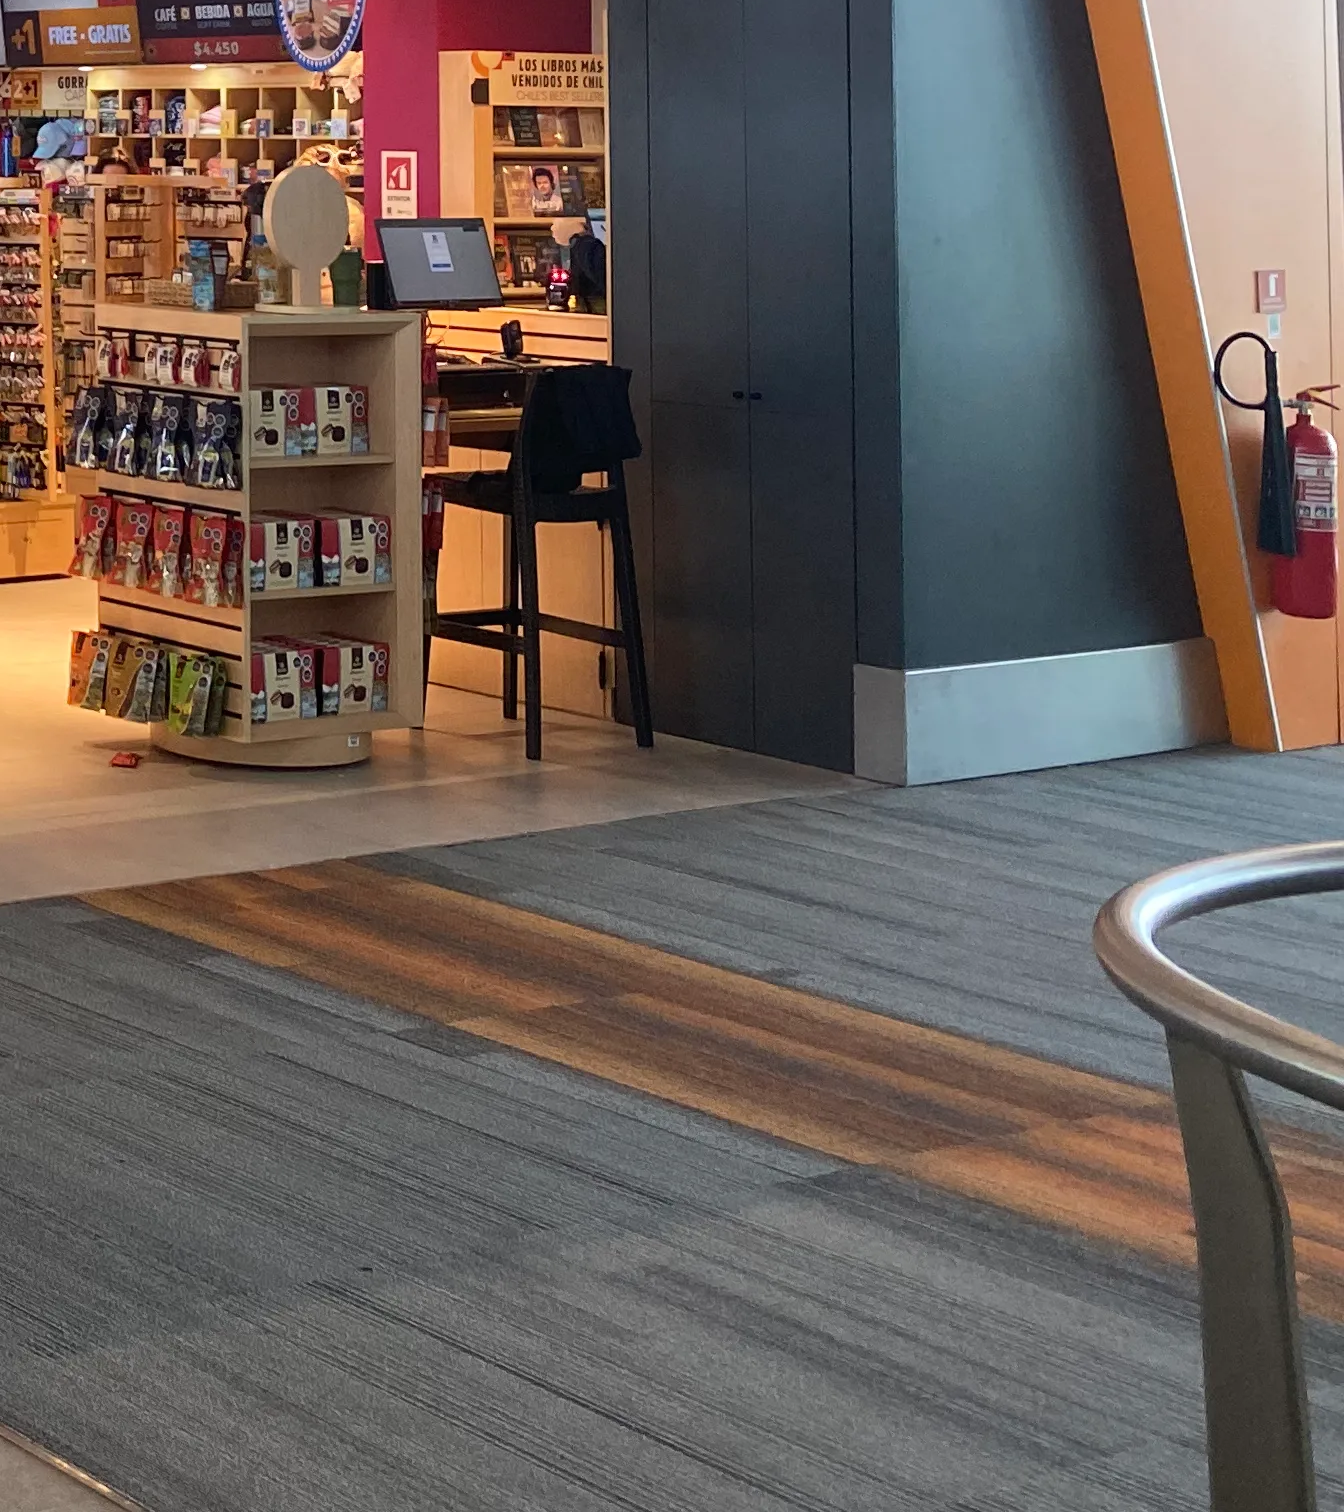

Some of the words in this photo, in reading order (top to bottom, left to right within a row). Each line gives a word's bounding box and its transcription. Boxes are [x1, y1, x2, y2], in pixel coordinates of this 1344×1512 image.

[154, 5, 177, 22] CAFÉ
[194, 5, 231, 19] BEBIDA
[48, 26, 77, 45] FREE
[88, 24, 131, 44] GRATIS
[194, 41, 239, 56] $4.450
[518, 58, 537, 72] LOS
[541, 59, 577, 73] LIBROS
[580, 58, 604, 73] MÁS
[511, 73, 563, 88] VENDIDOS
[566, 75, 579, 88] DE
